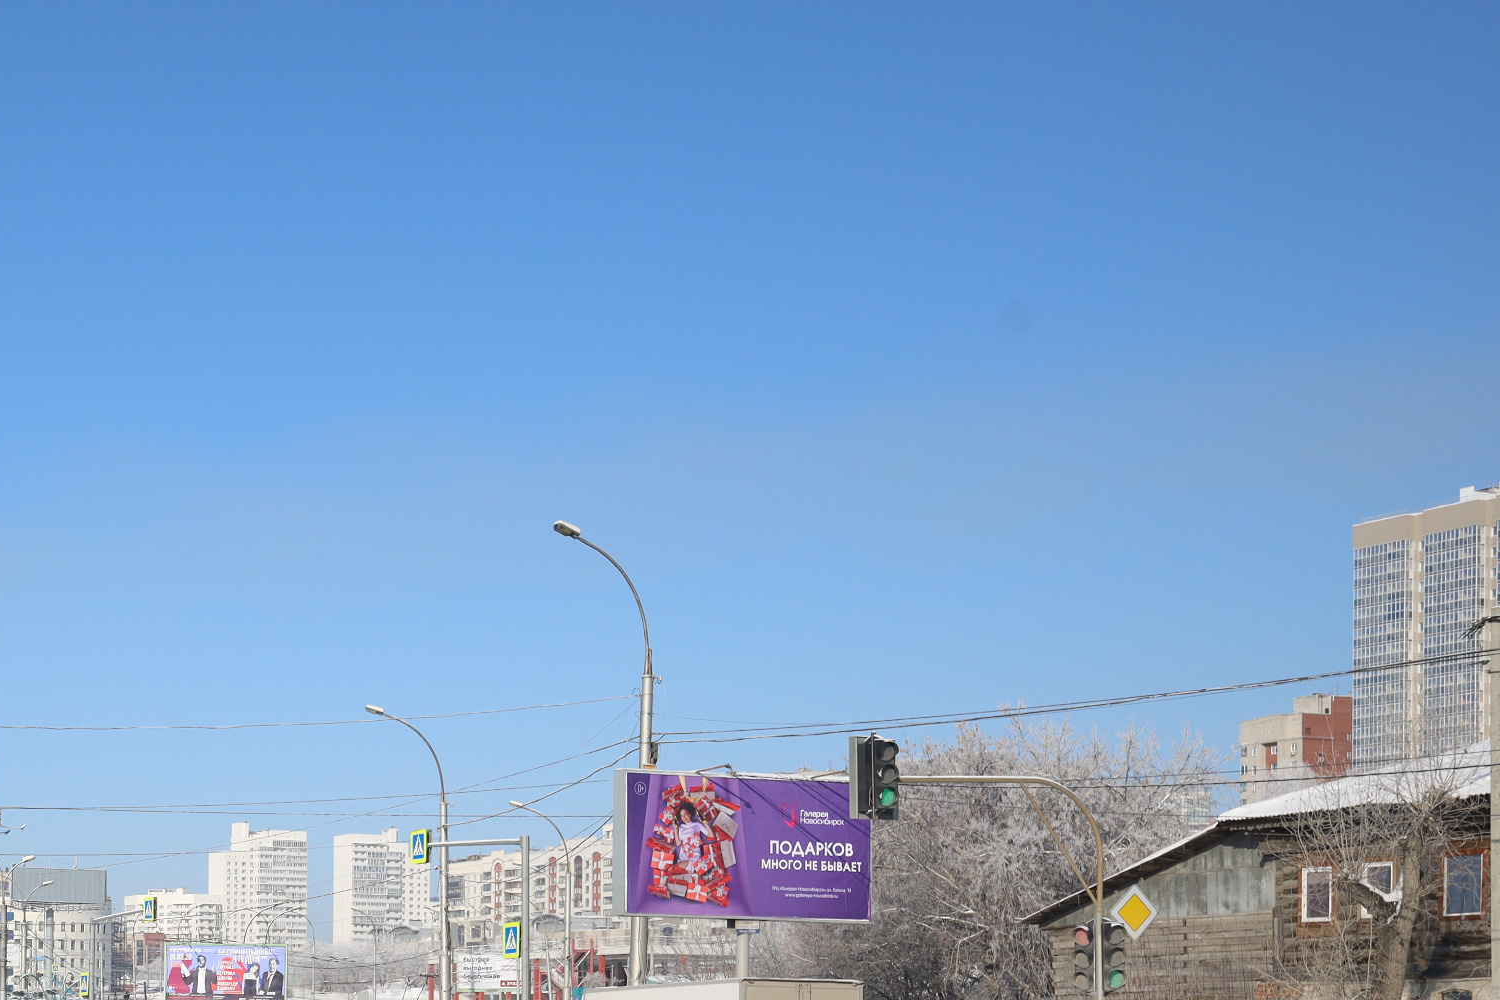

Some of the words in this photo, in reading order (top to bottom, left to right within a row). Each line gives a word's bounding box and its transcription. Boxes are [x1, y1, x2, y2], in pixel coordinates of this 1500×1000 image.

[636, 783, 645, 793] 0+
[800, 809, 829, 818] Галерея
[800, 817, 845, 827] Новосибирск
[769, 839, 854, 857] ПОДАРКОВ
[761, 858, 802, 871] МНОГО
[804, 860, 818, 871] НЕ
[820, 861, 862, 872] БЫВАЕТ
